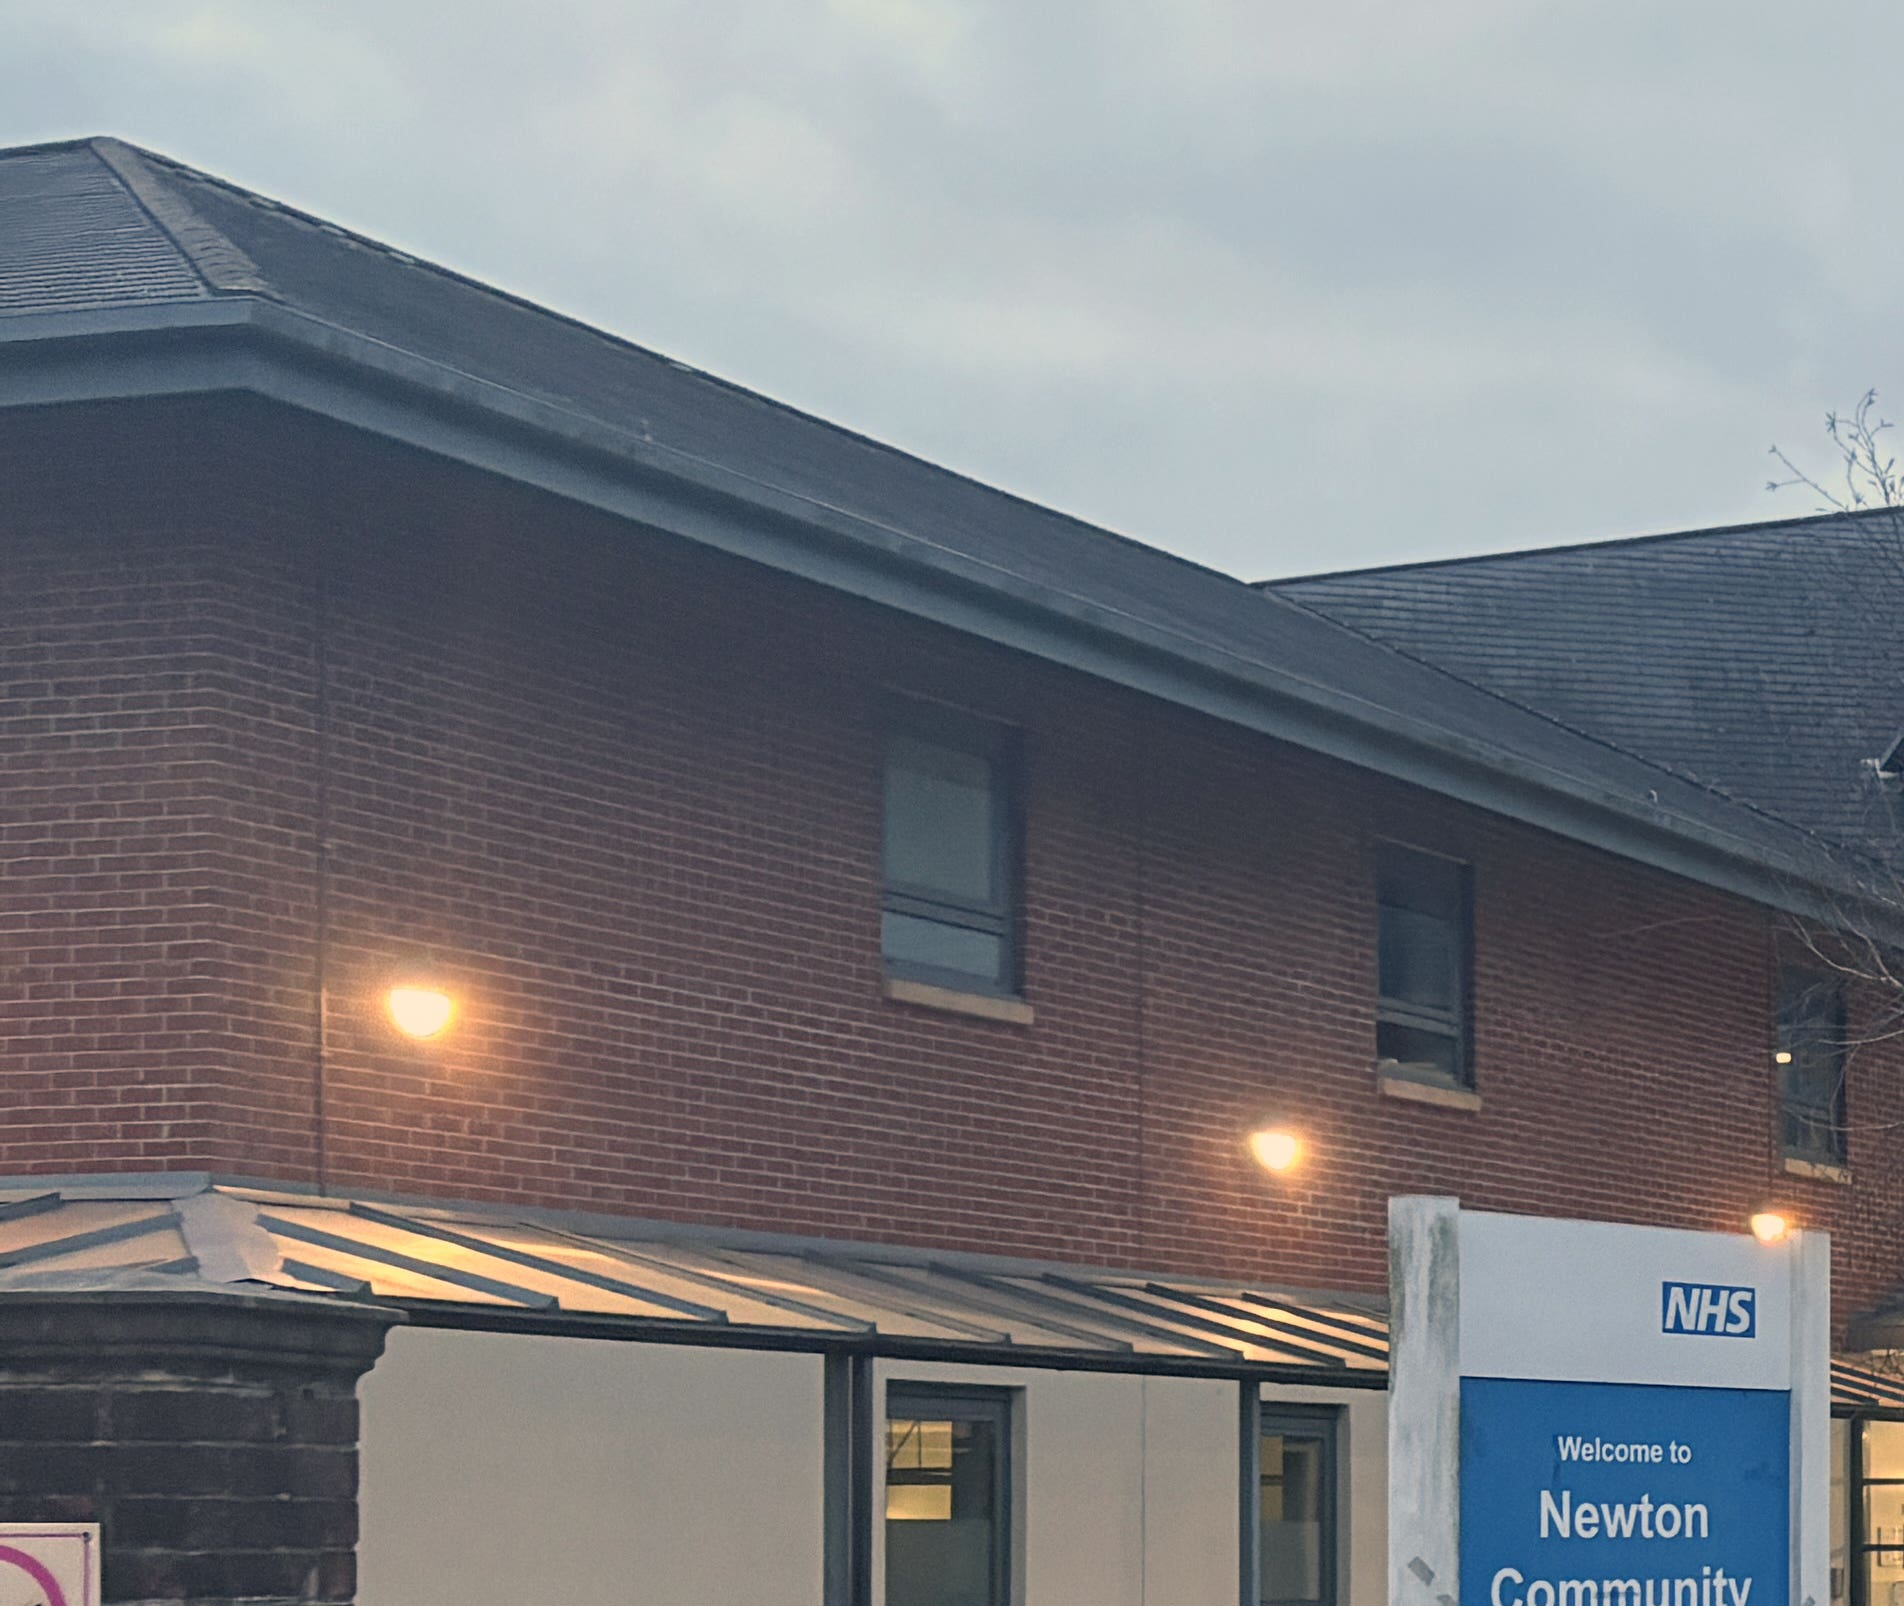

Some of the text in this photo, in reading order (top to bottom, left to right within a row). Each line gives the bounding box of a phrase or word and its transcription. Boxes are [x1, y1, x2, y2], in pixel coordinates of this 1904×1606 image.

[1664, 1284, 1753, 1335] NHS
[1558, 1437, 1691, 1463] Welcome to
[1540, 1490, 1708, 1538] Newton
